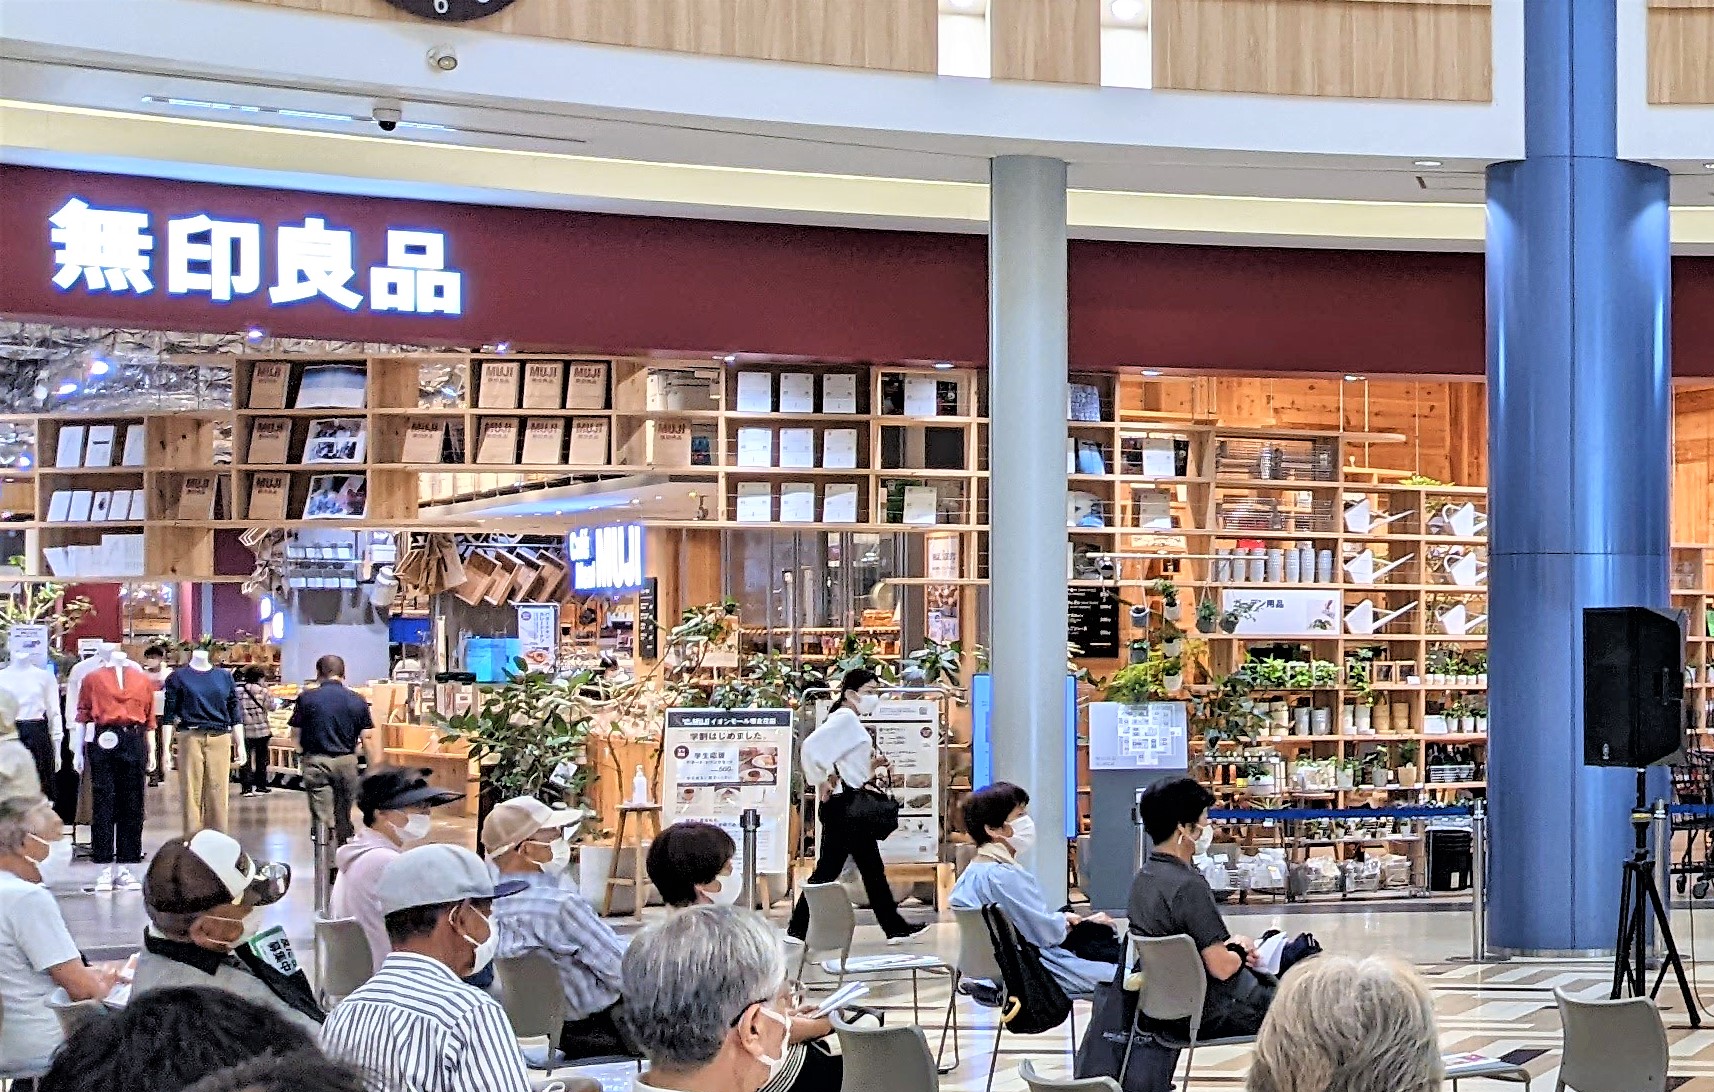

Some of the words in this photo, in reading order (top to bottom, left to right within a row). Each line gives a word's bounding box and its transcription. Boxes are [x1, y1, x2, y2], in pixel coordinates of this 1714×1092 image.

[49, 197, 463, 316] 無印良品
[485, 365, 513, 378] MUJI
[529, 366, 557, 378] MUJI
[574, 367, 601, 379] MUJI
